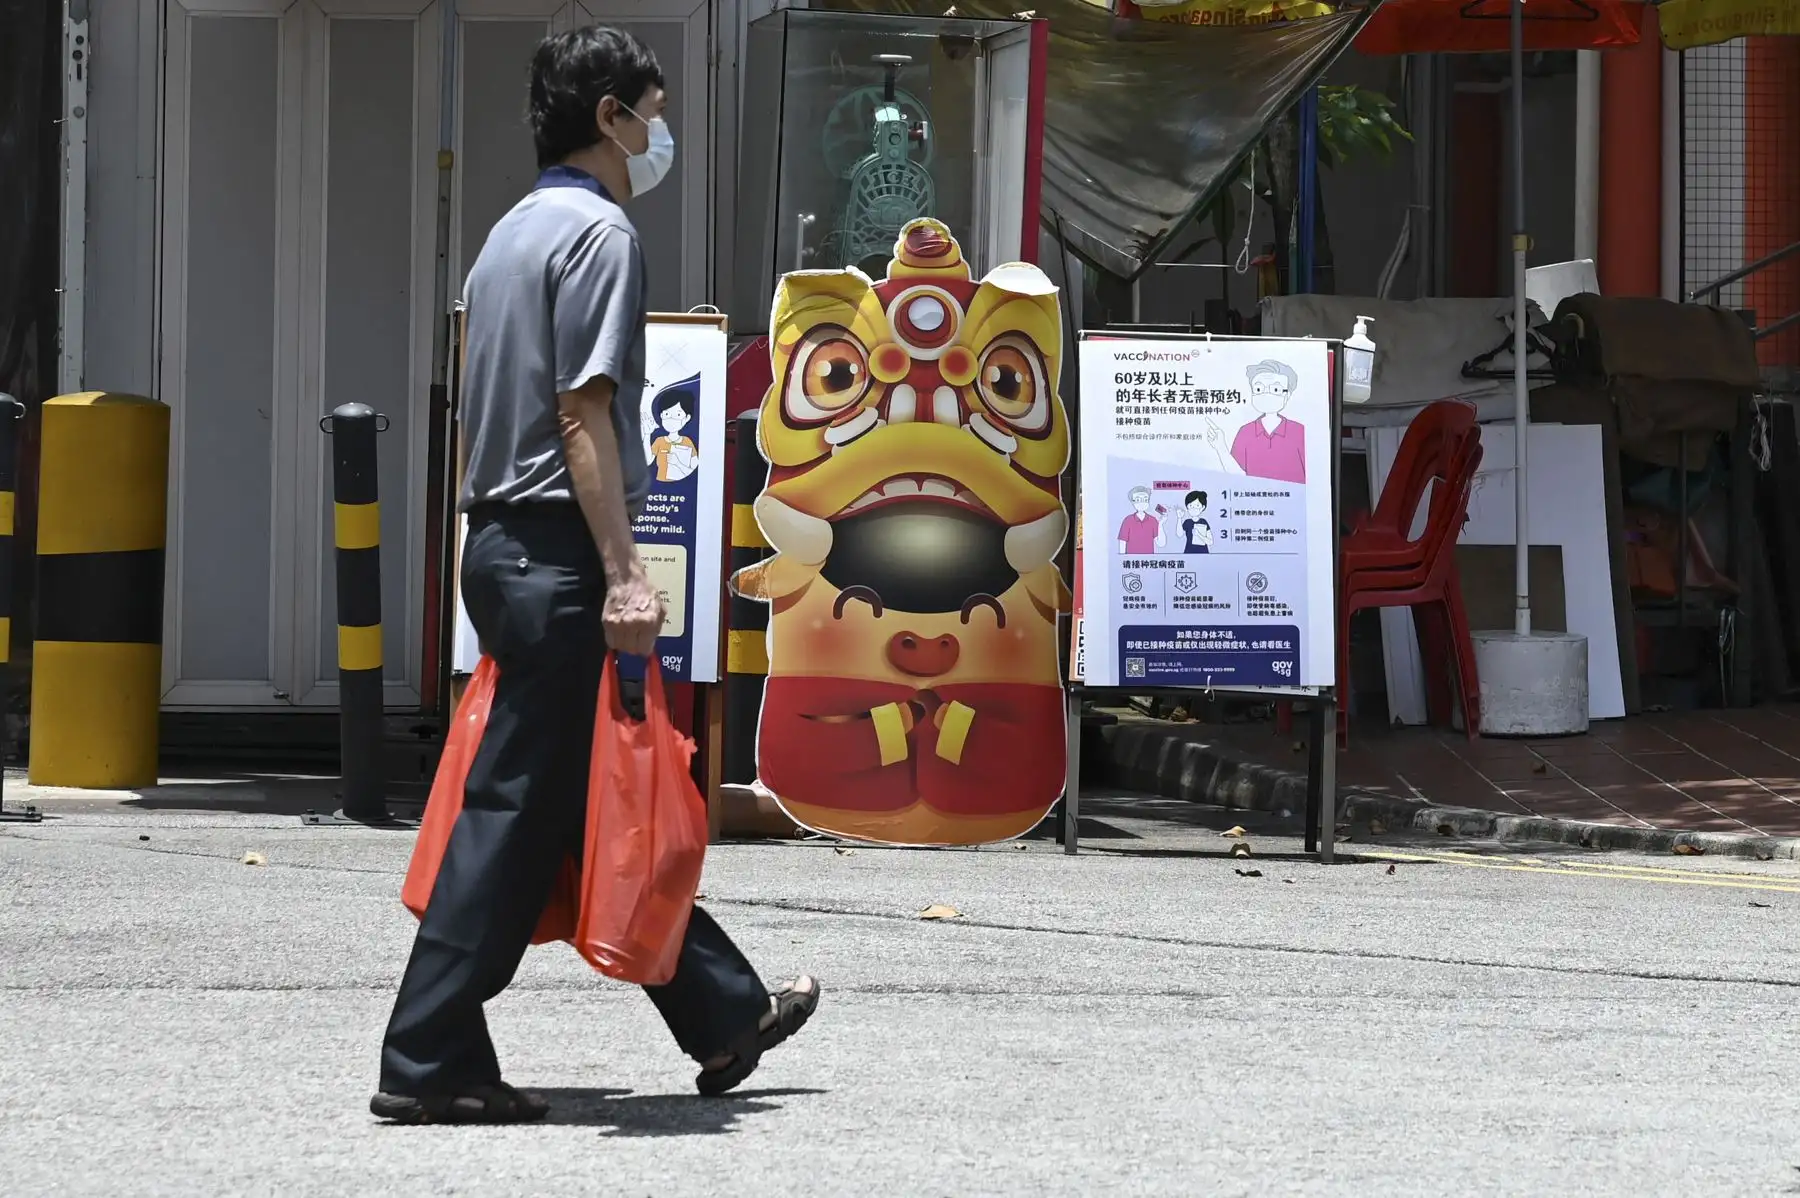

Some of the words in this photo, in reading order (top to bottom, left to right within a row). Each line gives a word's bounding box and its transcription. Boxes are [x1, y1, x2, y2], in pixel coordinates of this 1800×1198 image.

[1114, 351, 1191, 362] VACCINATION
[1114, 371, 1194, 386] 60岁及以上
[1115, 405, 1231, 415] 就可直接到任何疫苗接种中心
[1116, 417, 1151, 426] 接种疫苗
[647, 493, 667, 502] ects
[669, 494, 685, 502] are
[1221, 490, 1228, 499] 1
[1220, 509, 1228, 518] 2
[661, 525, 686, 534] mild.
[1220, 530, 1228, 539] 3
[1122, 560, 1185, 569] 请接种冠病疫苗
[662, 655, 684, 666] gov
[1272, 660, 1293, 671] gov
